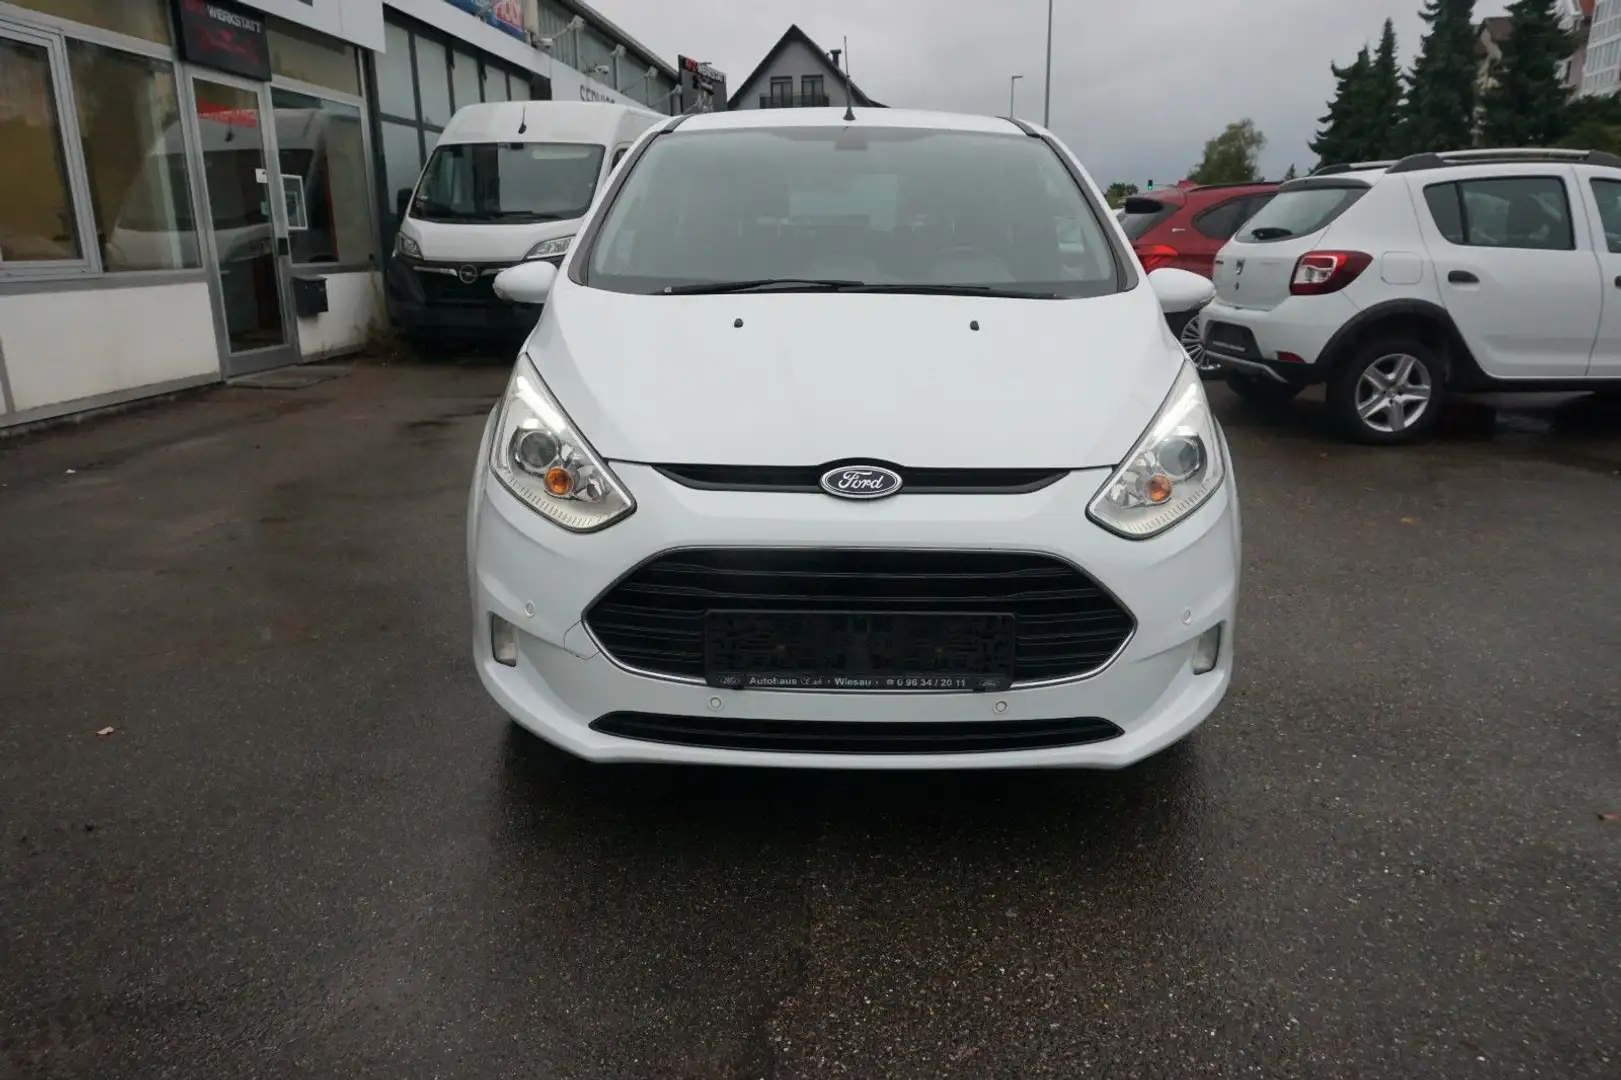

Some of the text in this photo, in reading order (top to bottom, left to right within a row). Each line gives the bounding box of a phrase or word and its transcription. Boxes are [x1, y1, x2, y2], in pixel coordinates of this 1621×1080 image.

[207, 4, 261, 33] WERKSTATT
[838, 471, 884, 489] Ford
[749, 676, 797, 685] Autohaus
[834, 677, 872, 686] Wiesau
[920, 678, 932, 687] 34
[941, 678, 953, 687] 20
[956, 678, 966, 687] 11
